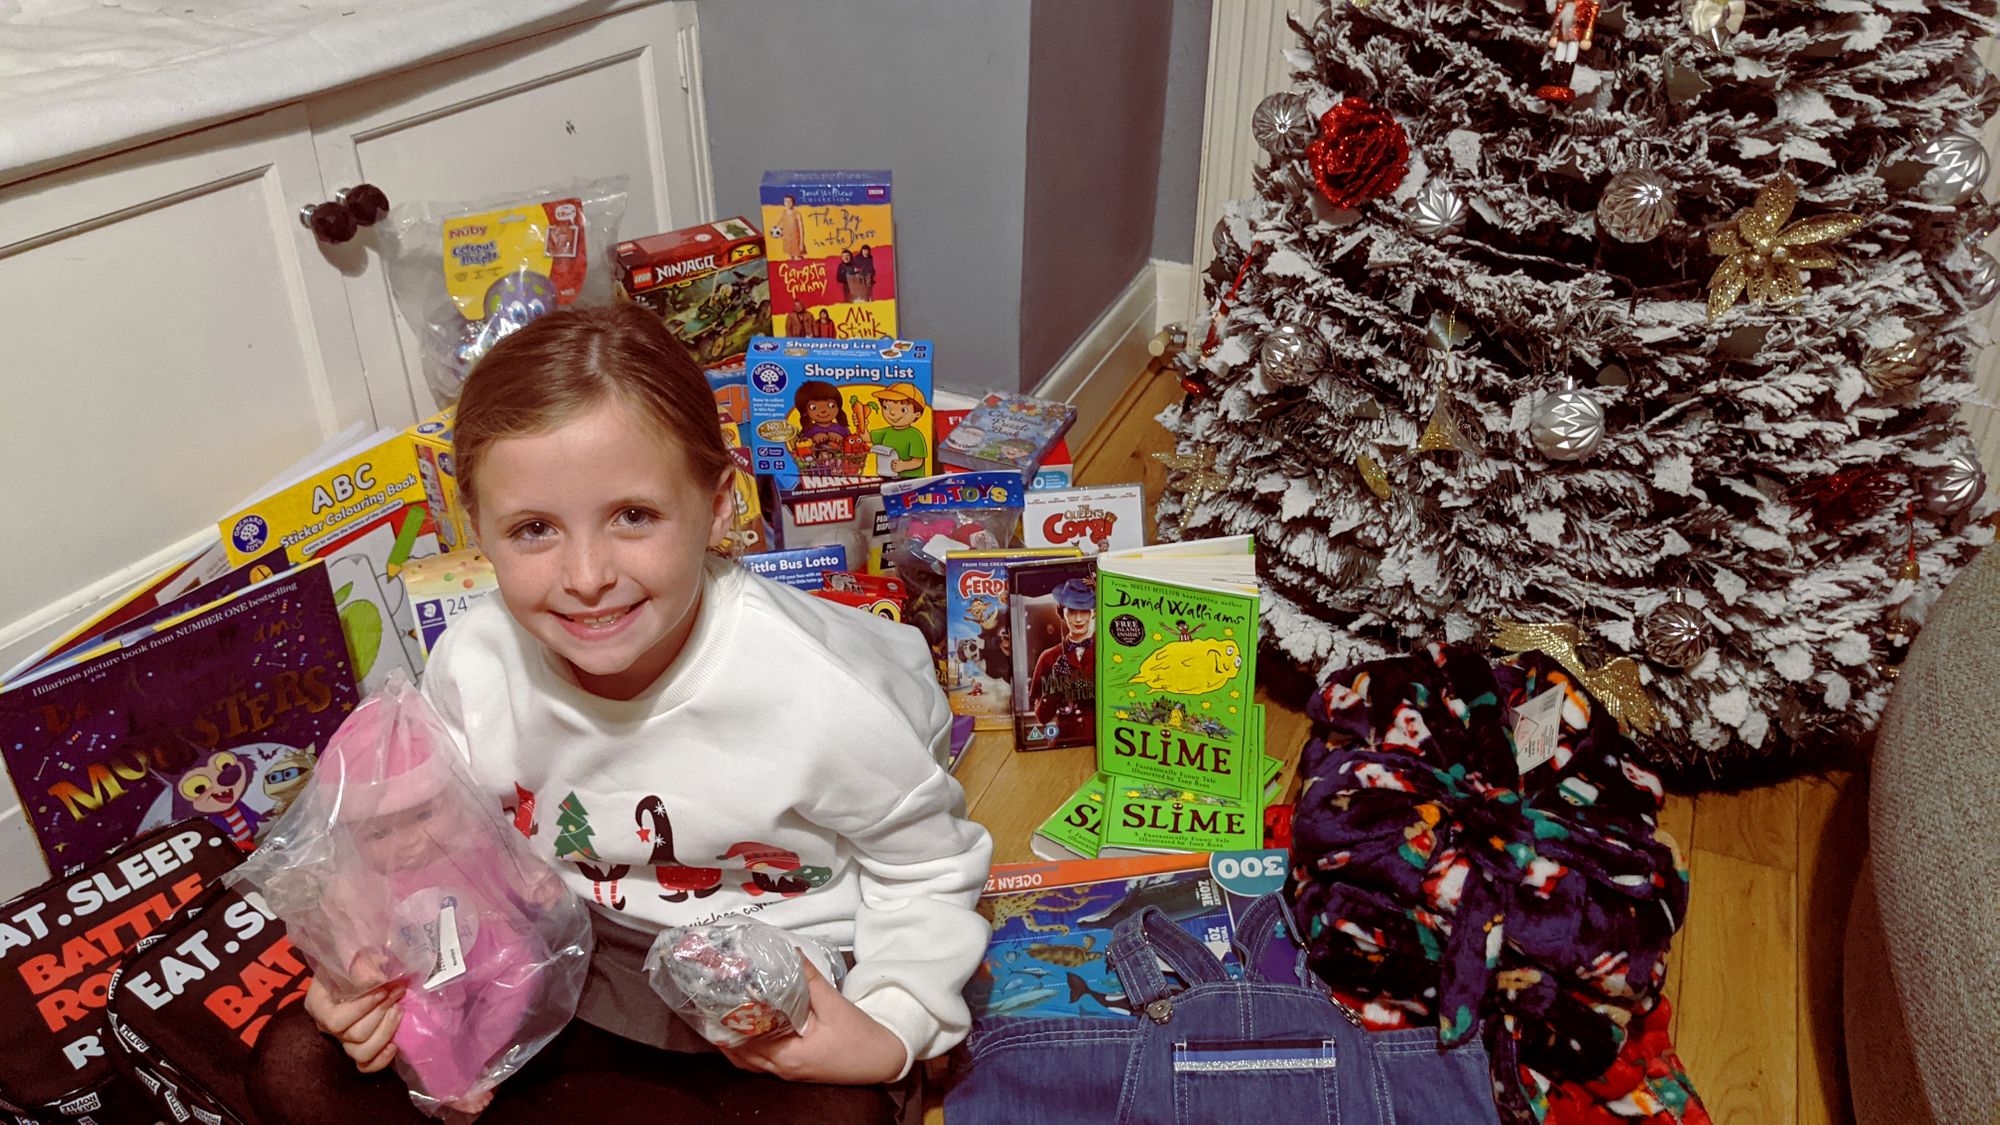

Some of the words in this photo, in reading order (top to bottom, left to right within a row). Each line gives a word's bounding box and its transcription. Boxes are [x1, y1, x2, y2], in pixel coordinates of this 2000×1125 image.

[808, 207, 834, 227] The
[656, 254, 720, 284] NINJAGO
[779, 262, 827, 285] Gangsta
[786, 279, 828, 300] Granny
[837, 318, 888, 340] Stink
[786, 341, 849, 350] Shopping
[853, 341, 879, 349] List
[754, 364, 785, 377] ORCHARD
[804, 364, 880, 381] Shopping
[885, 366, 914, 378] List
[312, 463, 376, 514] ABC
[902, 491, 947, 510] Fun
[947, 485, 1009, 503] TOYS
[279, 521, 325, 549] Sticker
[326, 491, 385, 526] Colouring
[386, 474, 417, 497] Book
[796, 499, 853, 525] MARVEL
[233, 515, 263, 537] ORCHARD
[1043, 511, 1114, 545] Corgi
[245, 539, 264, 553] TOYS
[780, 559, 802, 571] Bus
[806, 555, 839, 568] Lotto
[447, 596, 468, 616] 24
[1105, 588, 1164, 616] David
[1167, 600, 1245, 625] Walliams
[31, 672, 82, 698] Hilarious
[82, 655, 121, 680] picture
[121, 643, 148, 662] book
[150, 632, 175, 650] from
[176, 611, 224, 637] NUMBER
[223, 601, 248, 619] ONE
[248, 581, 298, 609] bestselling
[1114, 727, 1232, 775] SLIME
[1122, 802, 1246, 835] SLIME
[1217, 856, 1285, 879] 300
[998, 873, 1042, 891] OCEAN
[1197, 879, 1214, 907] ZONE
[17, 872, 203, 995] BATTLE
[203, 934, 306, 1029] BAT
